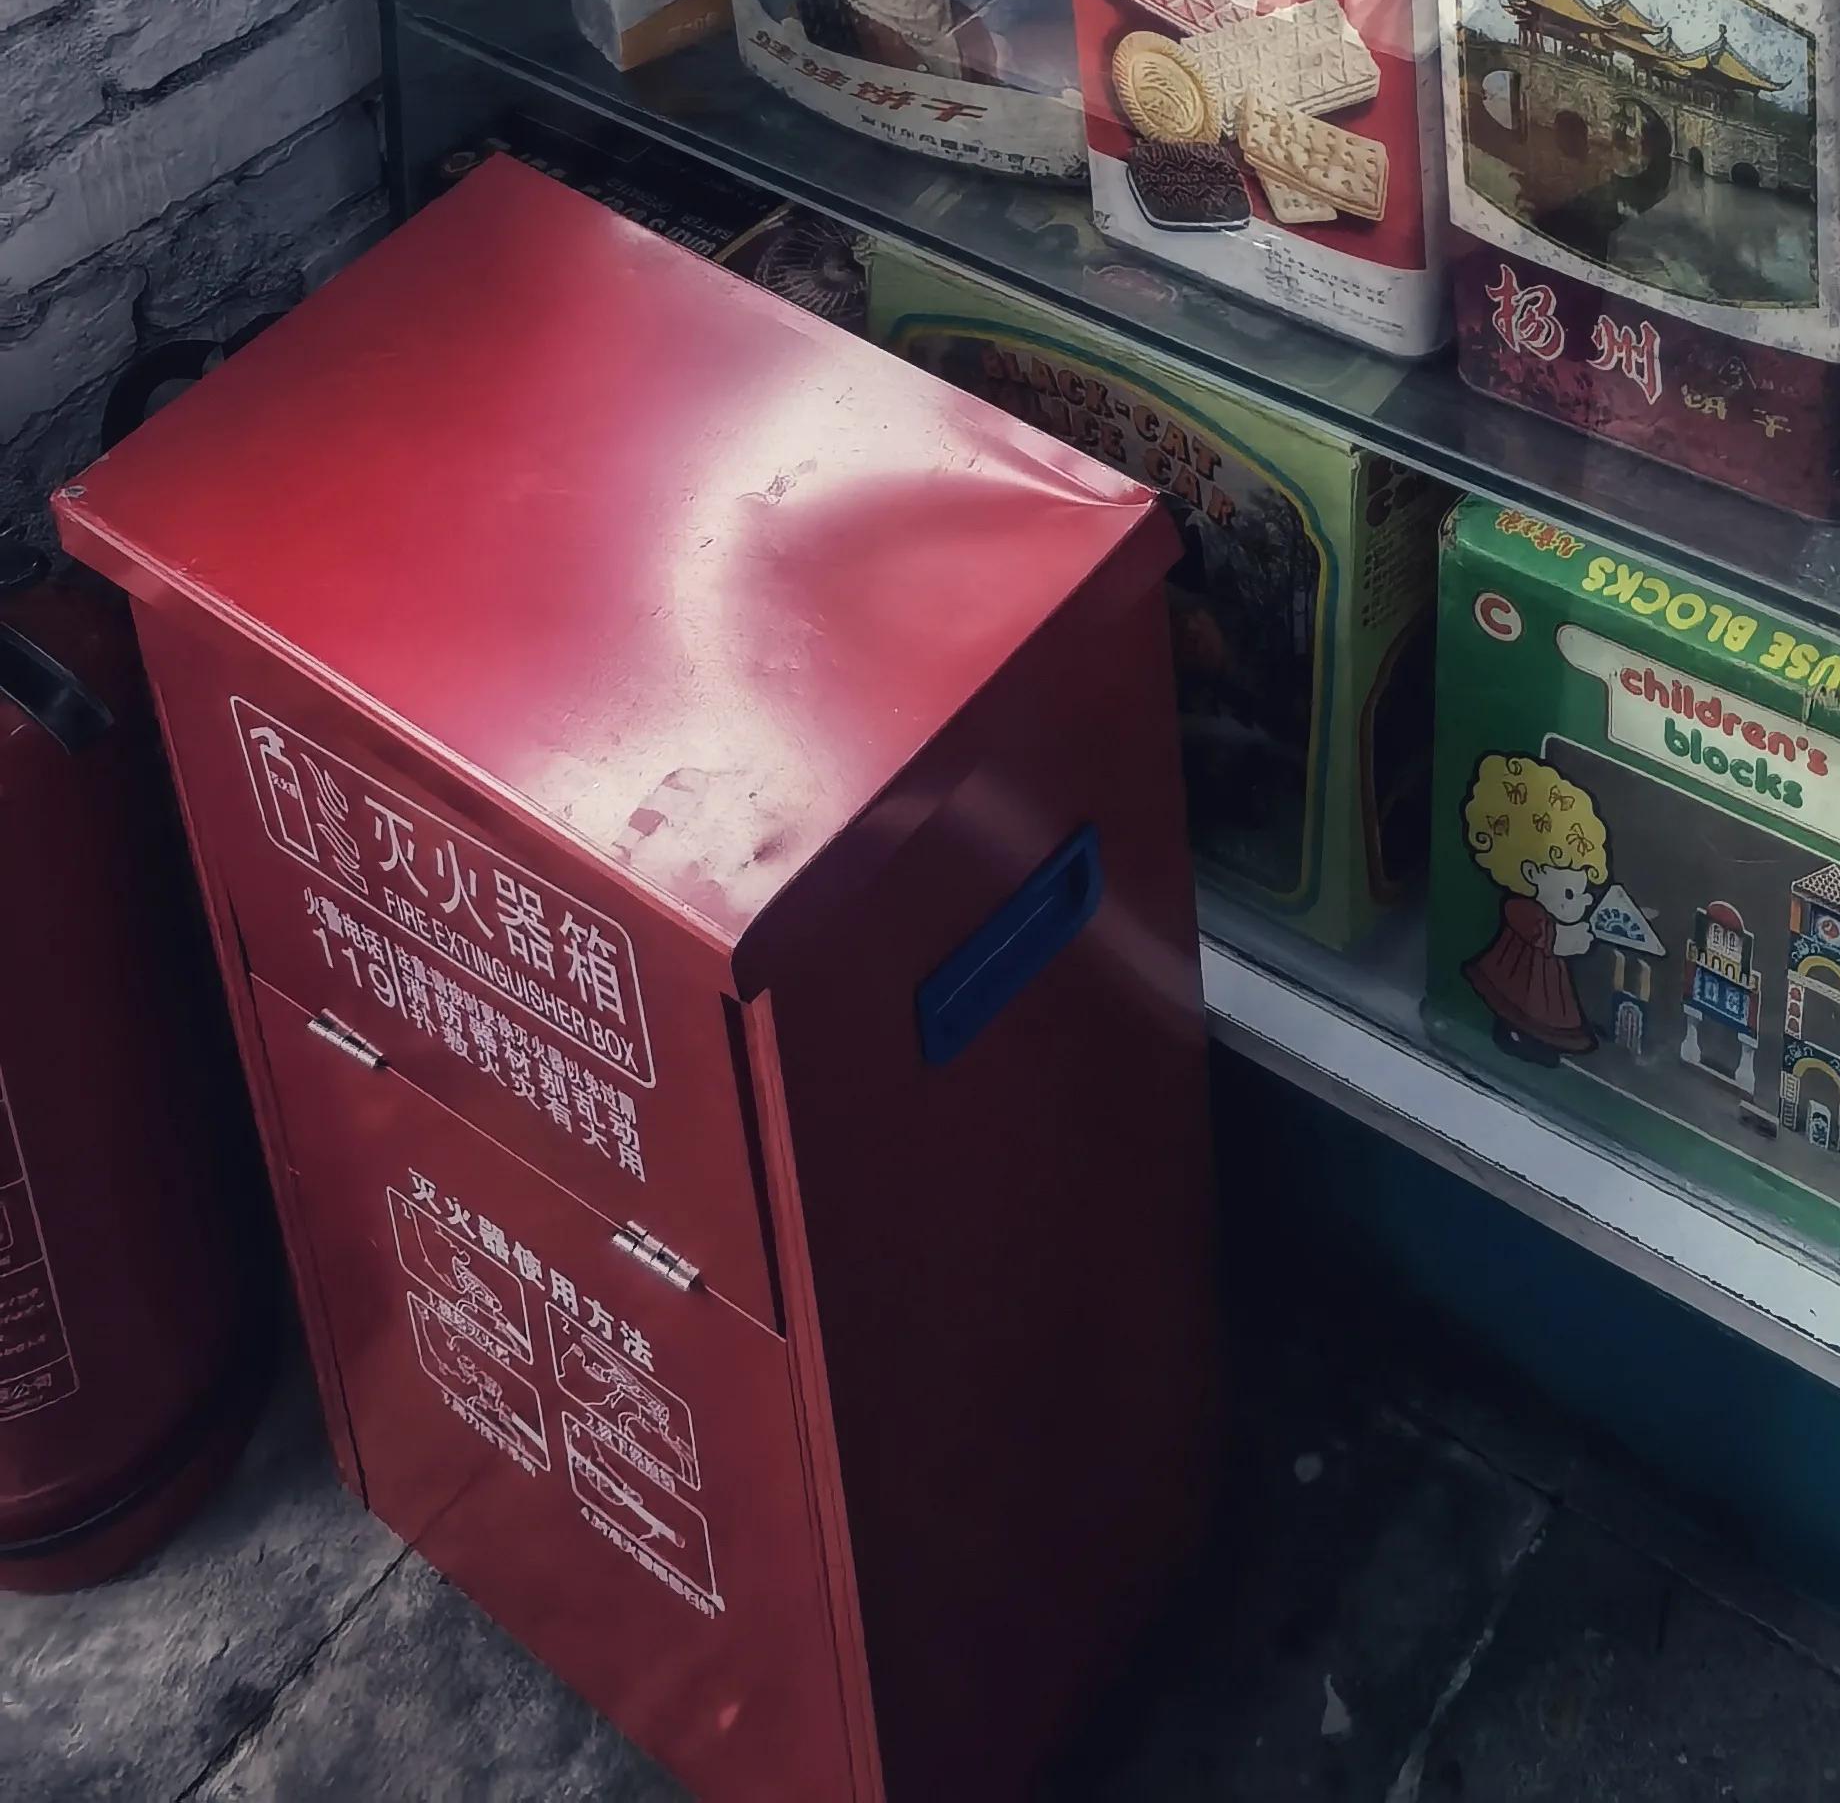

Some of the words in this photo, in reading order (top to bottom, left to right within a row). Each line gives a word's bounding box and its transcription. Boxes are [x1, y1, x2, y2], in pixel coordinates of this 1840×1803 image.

[1486, 263, 1663, 405] 扬州
[1144, 438, 1238, 528] CAR
[1581, 555, 1754, 653] BLOCKS
[1618, 665, 1831, 778] children's
[1663, 718, 1805, 811] blocks
[365, 795, 626, 1024] 灭火器箱
[314, 928, 397, 1009] 119
[383, 887, 432, 941] FIRE
[432, 922, 591, 1047] EXTINGUISHER
[589, 1022, 639, 1073] BOX
[408, 1167, 655, 1372] 灭火器使用方法
